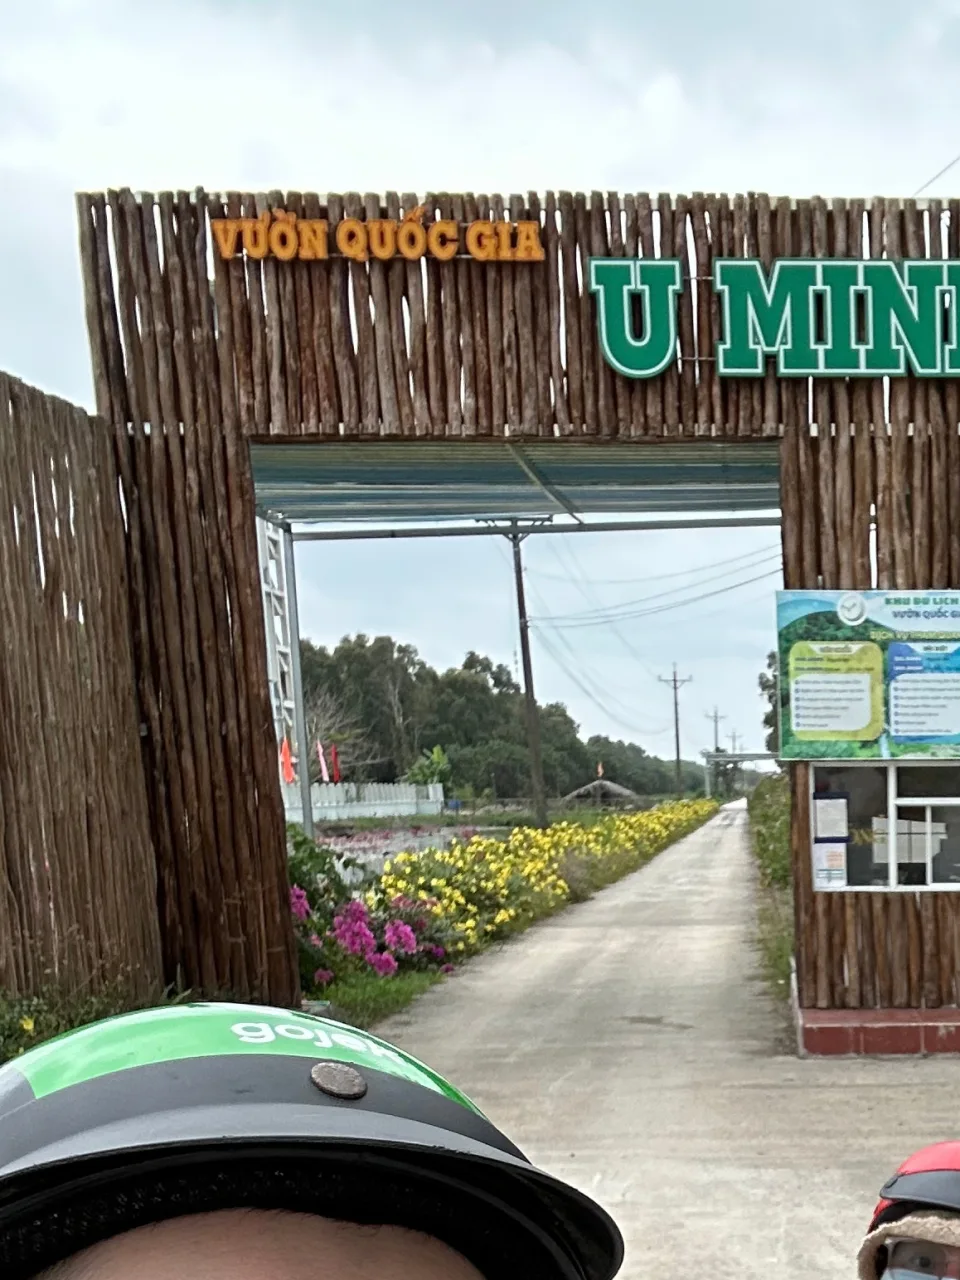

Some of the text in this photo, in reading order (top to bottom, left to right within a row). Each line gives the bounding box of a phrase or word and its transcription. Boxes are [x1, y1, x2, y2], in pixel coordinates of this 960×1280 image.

[336, 206, 459, 262] QUỐC
[465, 220, 545, 261] GIA
[588, 255, 682, 379] U
